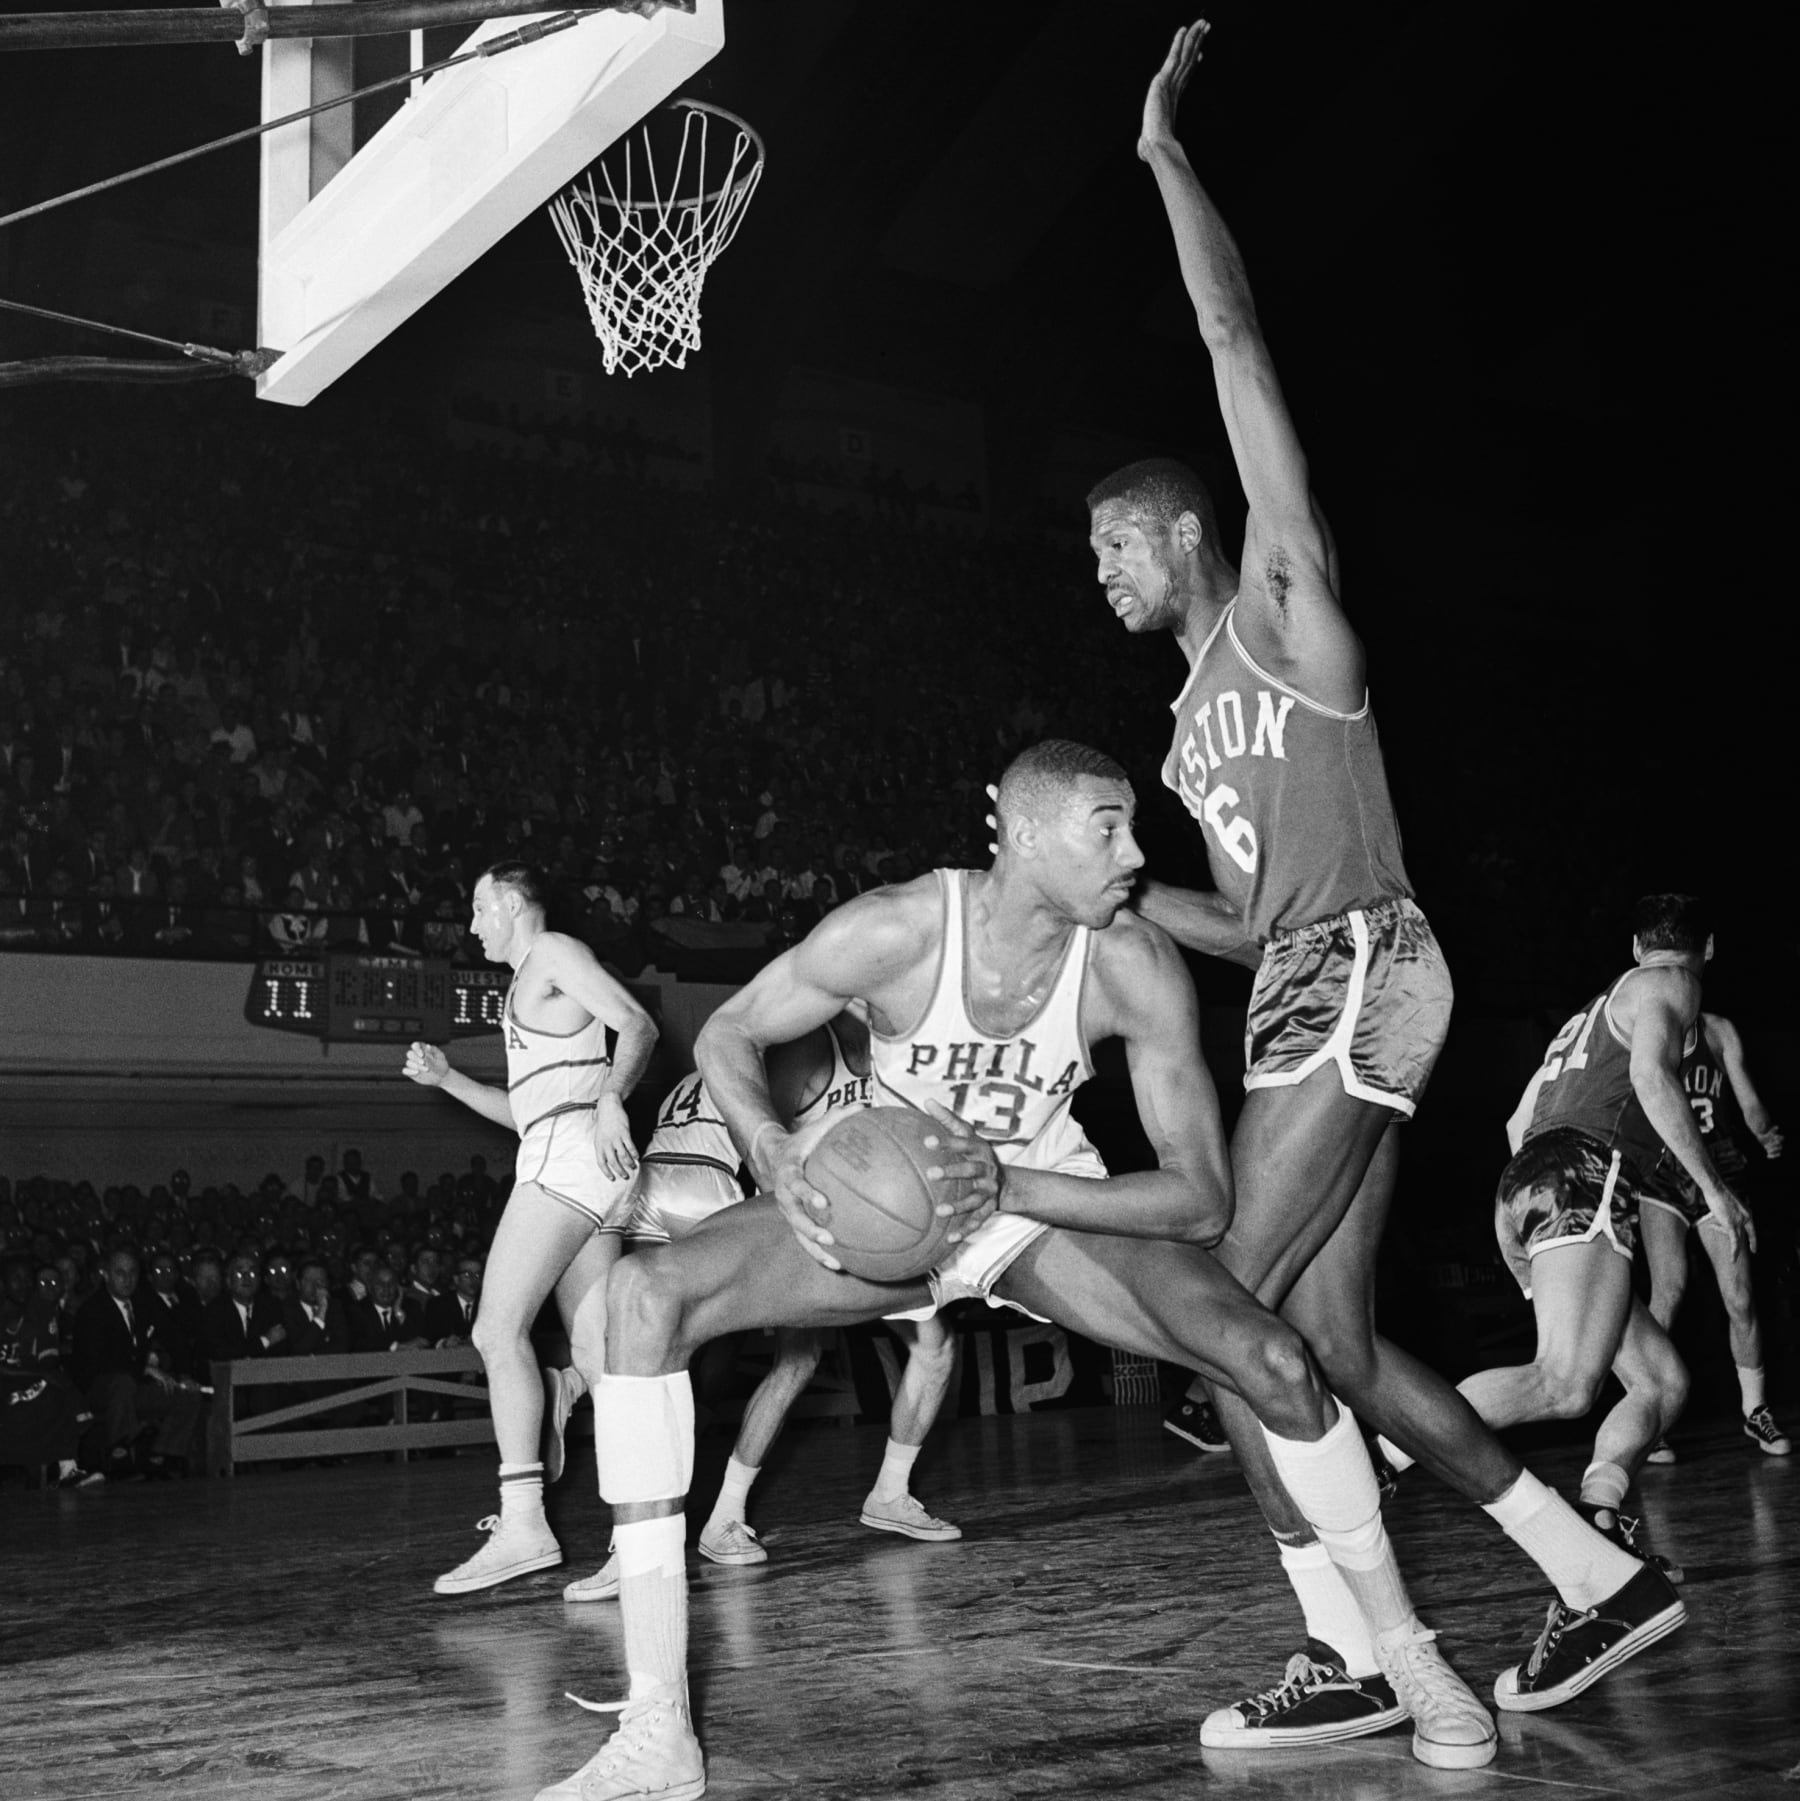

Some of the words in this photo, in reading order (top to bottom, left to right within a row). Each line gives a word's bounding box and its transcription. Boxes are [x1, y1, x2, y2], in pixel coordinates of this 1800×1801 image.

[1204, 783, 1258, 874] 6
[269, 963, 319, 977] HOME
[449, 972, 502, 986] GUEST
[264, 980, 312, 1018] 11
[1544, 995, 1607, 1081] 21
[906, 1038, 1079, 1096] PHILA
[662, 1078, 702, 1123] 14
[827, 1078, 873, 1111] PHI
[949, 1082, 1026, 1138] 13
